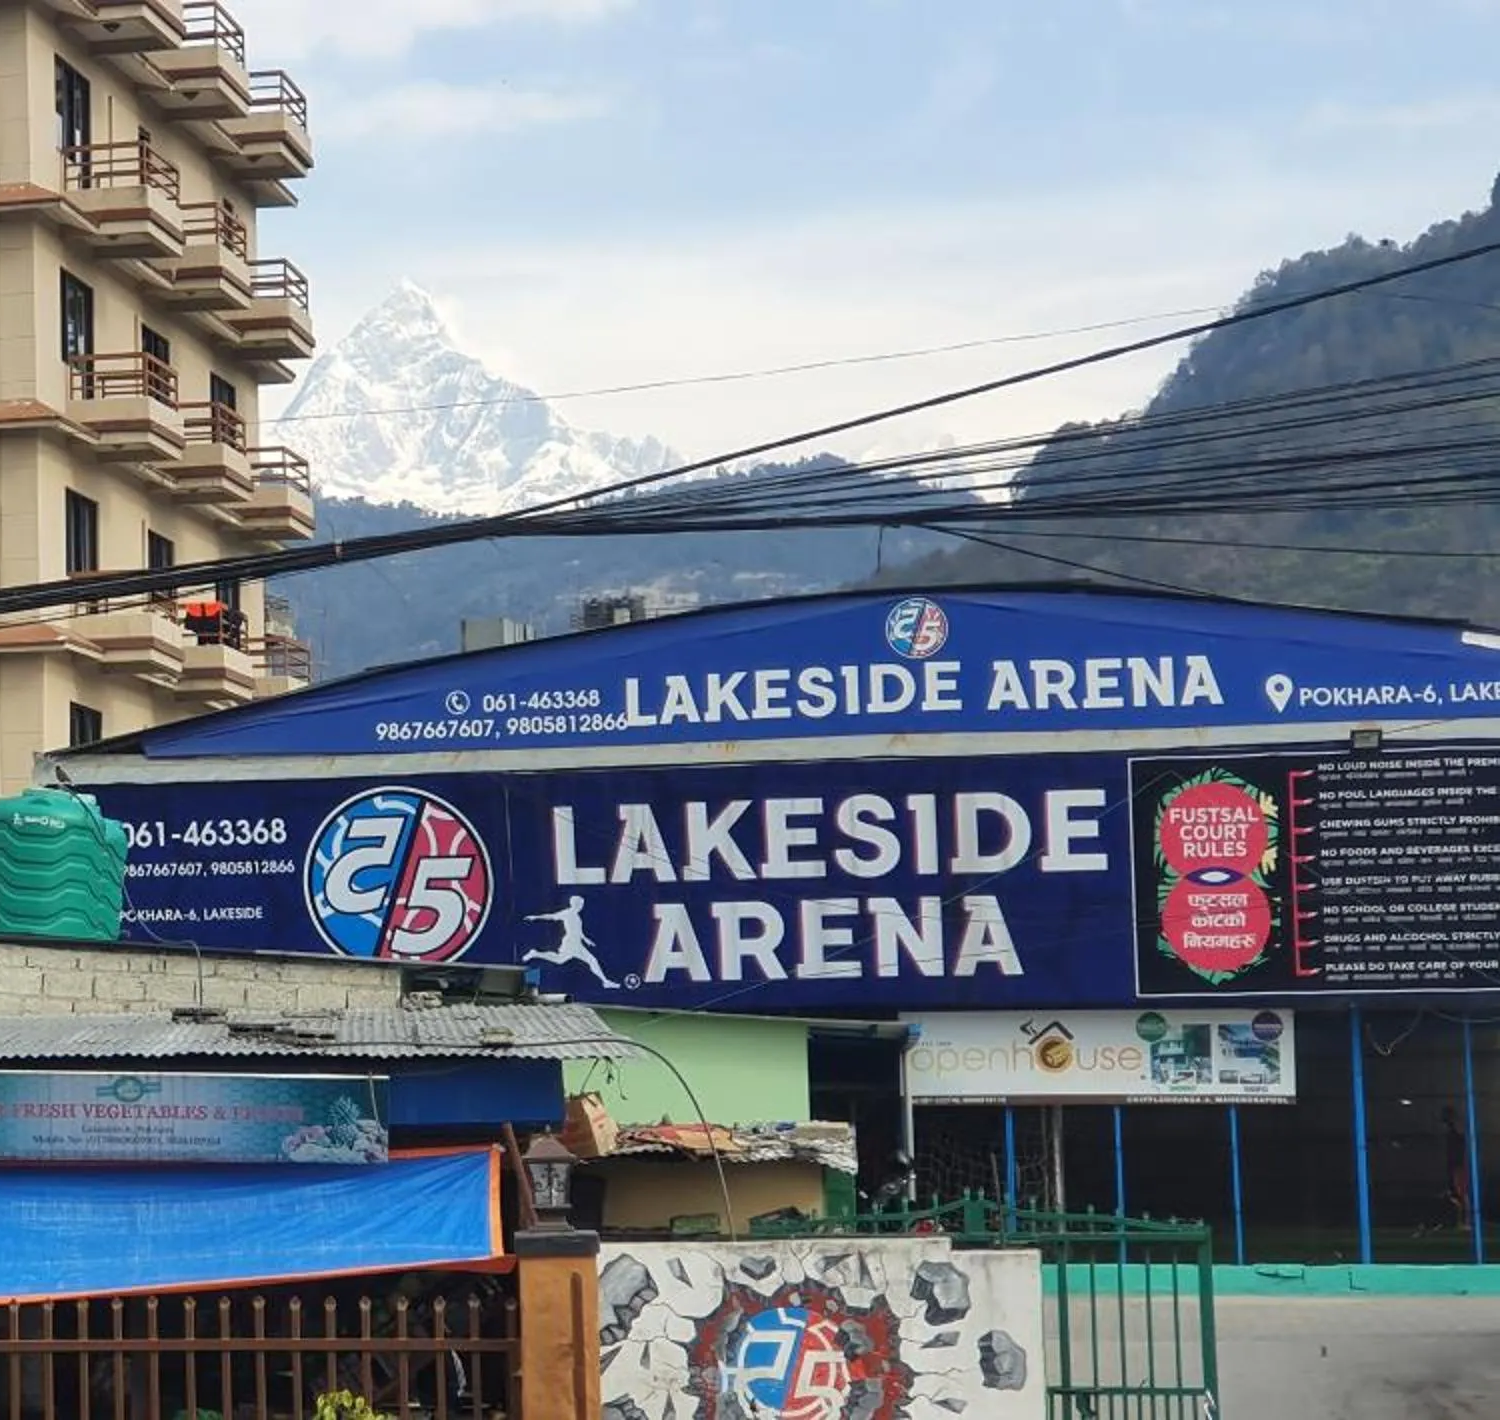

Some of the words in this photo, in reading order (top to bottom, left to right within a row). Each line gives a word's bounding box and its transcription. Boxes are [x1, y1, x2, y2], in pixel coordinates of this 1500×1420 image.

[624, 662, 962, 727] LAKESIDE
[987, 656, 1225, 711] ARENA
[1300, 684, 1442, 706] POKHARA-6,
[483, 690, 600, 713] 061-463368
[376, 719, 500, 742] 9867667607,
[506, 713, 628, 736] 9805812866
[1318, 763, 1335, 771] NO
[1338, 762, 1367, 771] LOUD
[1370, 760, 1402, 769] NOISE
[1405, 759, 1440, 768] INSIDE
[1444, 757, 1465, 767] THE
[1319, 791, 1336, 800] NO
[1338, 790, 1367, 799] FOUL
[1369, 787, 1435, 798] LANGUAGES
[1437, 787, 1473, 796] INSIDE
[1476, 786, 1497, 795] THE
[1169, 807, 1259, 825] FUSTSAL
[1320, 819, 1371, 829] CHEWING
[1373, 817, 1405, 827] GUMS
[1407, 816, 1457, 826] STRICTLY
[553, 789, 1109, 885] LAKESIDE
[1180, 824, 1249, 841] COURT
[1184, 841, 1247, 858] RULES
[1321, 848, 1337, 857] NO
[1340, 847, 1377, 856] FOODS
[1381, 847, 1404, 855] AND
[1406, 844, 1470, 855] BEVERAGES
[211, 860, 295, 876] 9805812866
[1321, 876, 1342, 886] USE
[1395, 875, 1409, 884] TO
[1411, 874, 1431, 884] PUT
[1435, 873, 1466, 883] AWAY
[204, 906, 263, 921] LAKESIDE
[1323, 905, 1339, 915] NO
[1342, 904, 1386, 914] SCHOOL
[1407, 902, 1457, 912] COLLEGE
[644, 895, 1025, 983] ARENA
[1323, 933, 1361, 943] DRUGS
[1364, 933, 1387, 942] AND
[1325, 962, 1365, 972] PLEASE
[1368, 961, 1385, 971] DO
[1387, 961, 1415, 970] TAKE
[1417, 961, 1447, 970] CARE
[1451, 961, 1465, 969] OF
[1468, 960, 1499, 969] YOUR
[82, 1103, 208, 1120] VEGETABLES
[214, 1106, 227, 1120] &
